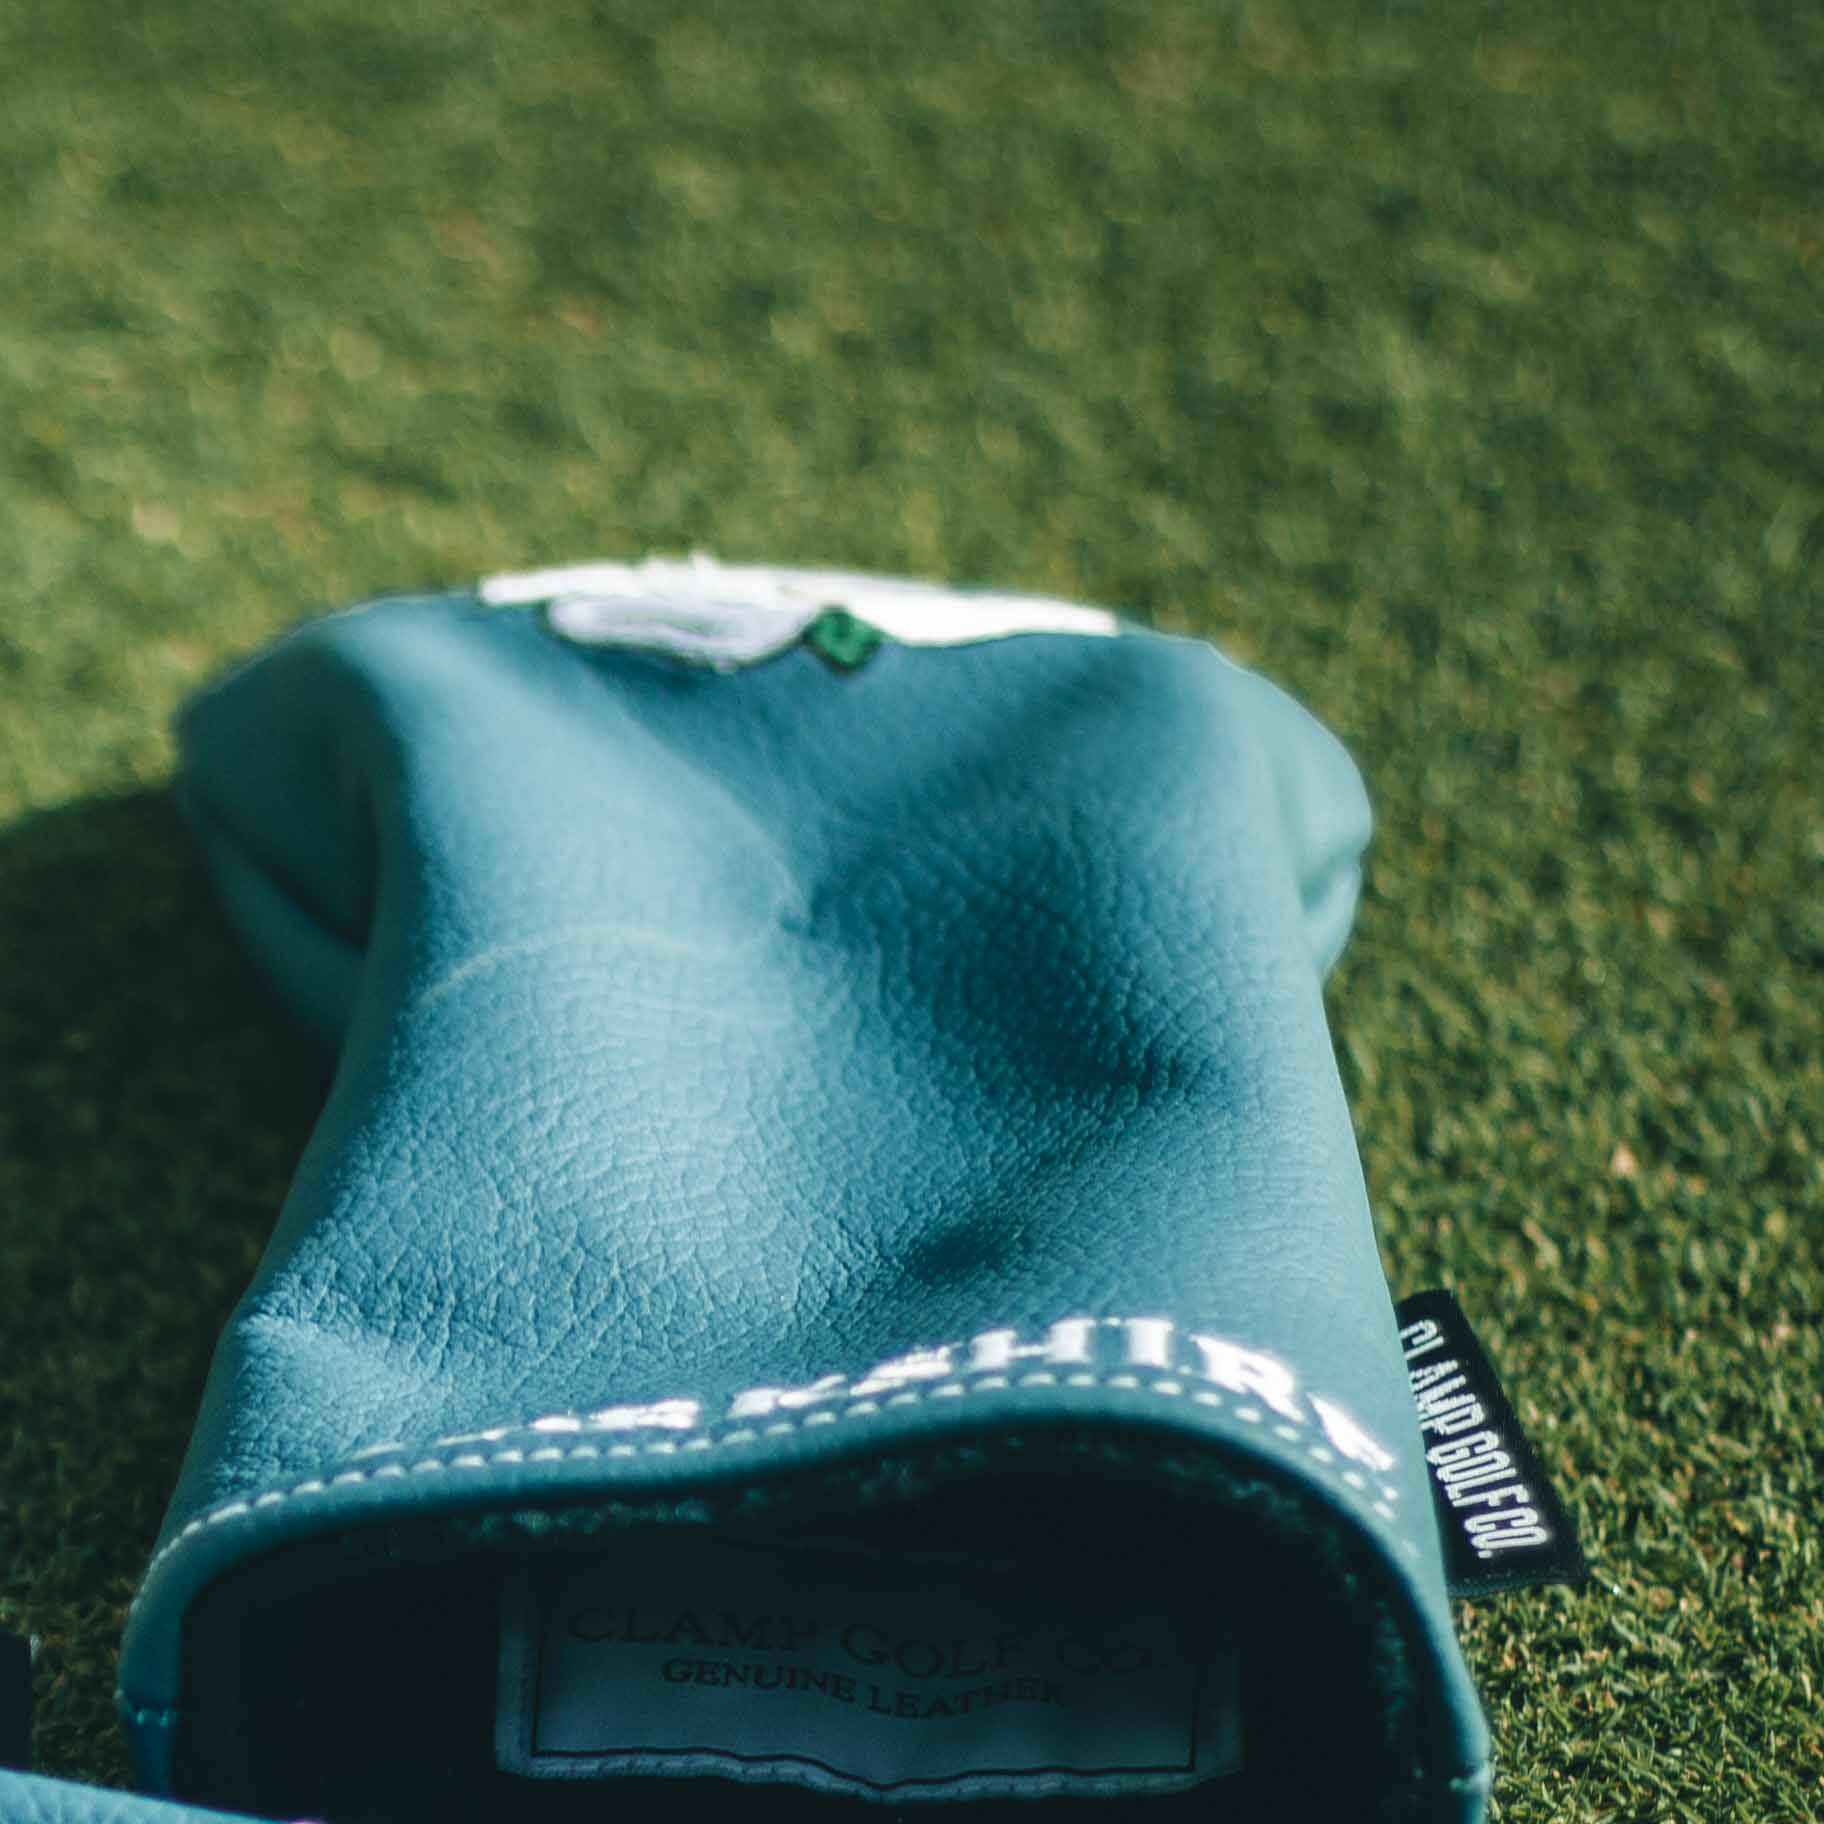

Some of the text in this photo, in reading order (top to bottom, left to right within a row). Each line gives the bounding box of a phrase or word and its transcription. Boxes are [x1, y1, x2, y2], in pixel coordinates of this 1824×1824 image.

[1426, 1430, 1530, 1508] GOLF
[1464, 1507, 1550, 1559] CO.
[566, 1606, 820, 1654] CLAMP
[840, 1620, 1028, 1681] GOLF
[662, 1657, 1068, 1721] GENUINE LEATHER
